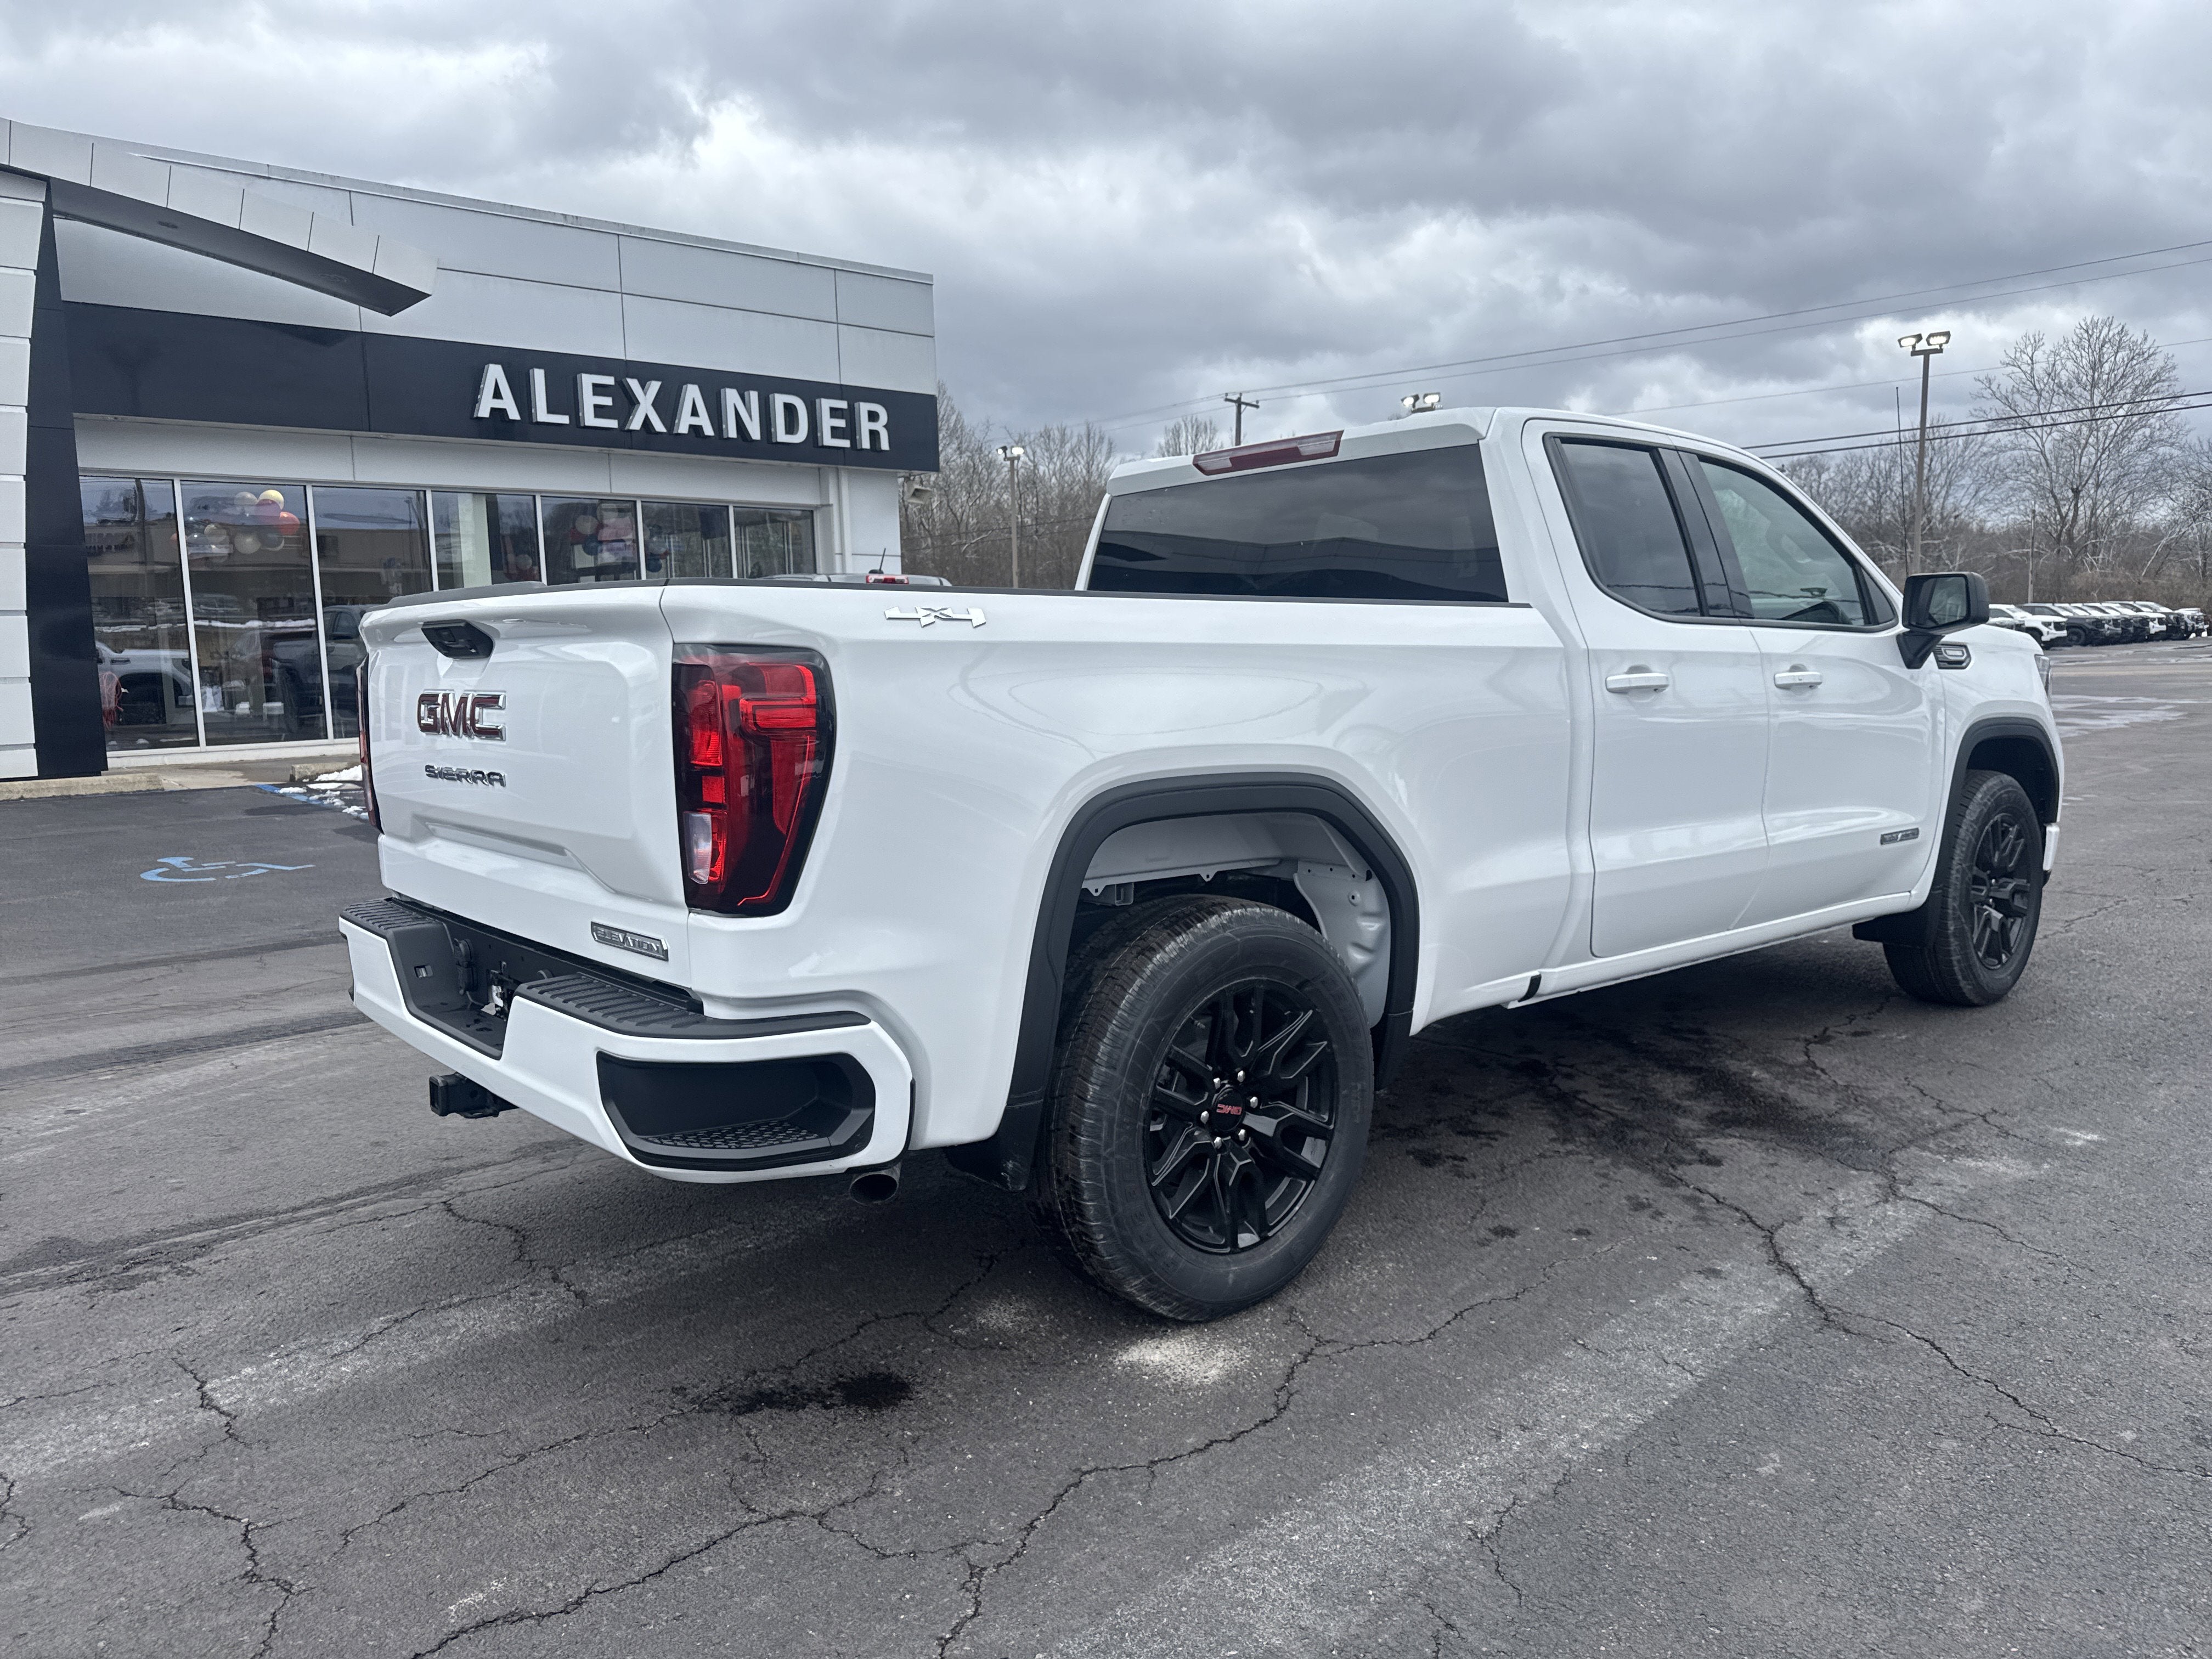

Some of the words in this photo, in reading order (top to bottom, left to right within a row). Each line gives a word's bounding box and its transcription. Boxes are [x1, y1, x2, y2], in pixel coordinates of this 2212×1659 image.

[473, 363, 890, 450] ALEXANDER
[417, 690, 506, 741] GMC
[425, 765, 506, 787] SIERRA
[1216, 1103, 1242, 1115] GMC
